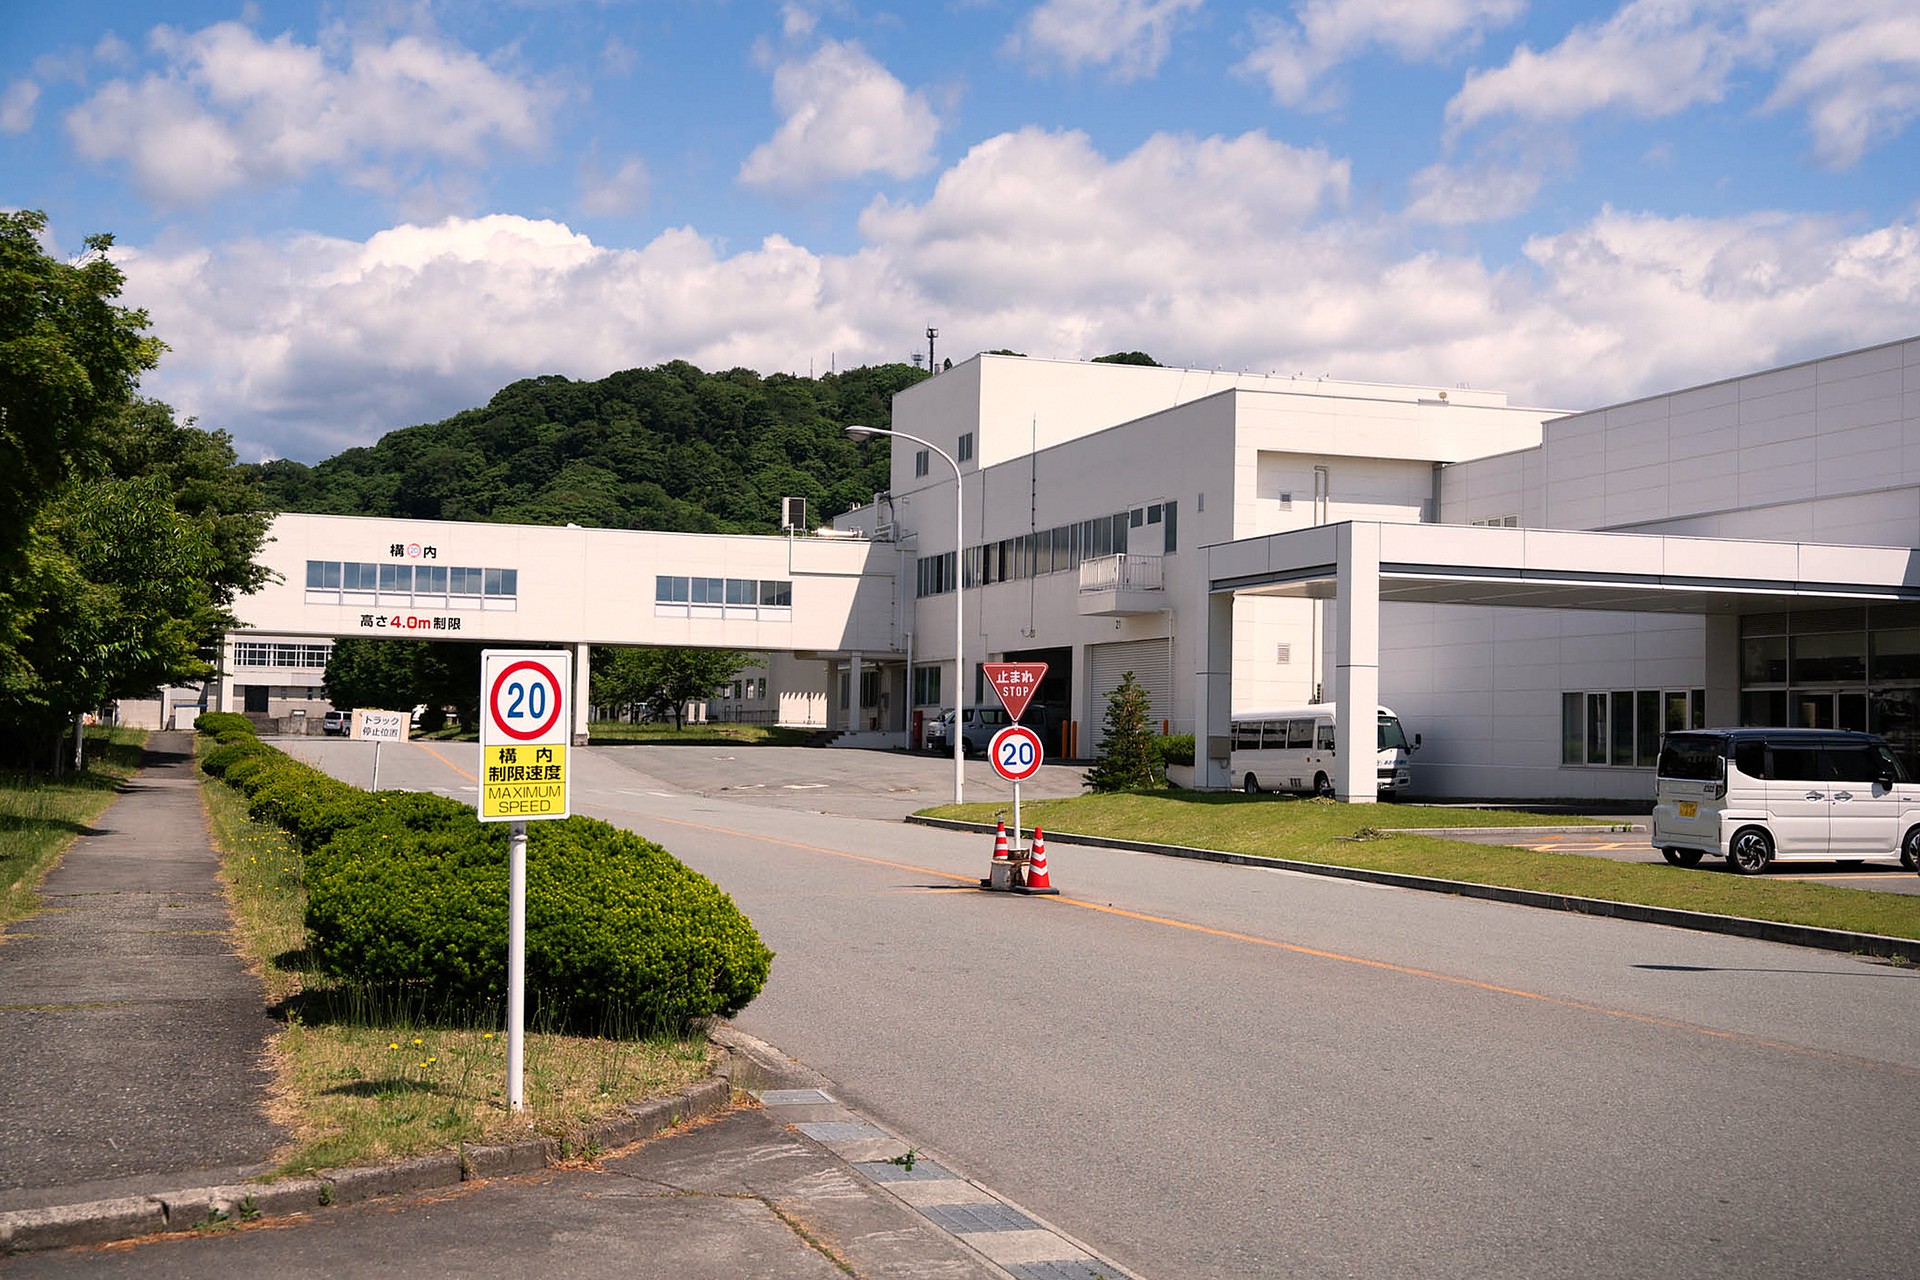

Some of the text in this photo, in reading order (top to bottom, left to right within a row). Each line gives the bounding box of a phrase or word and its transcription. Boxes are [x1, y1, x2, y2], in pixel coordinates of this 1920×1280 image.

[996, 670, 1034, 684] 止まれ
[1003, 686, 1029, 697] STOP
[507, 682, 546, 719] 20
[365, 715, 400, 726] トラック
[1003, 742, 1034, 766] 20
[489, 765, 561, 782] 制限速度
[489, 785, 561, 799] MAXIMUM
[498, 799, 551, 813] SPEED
